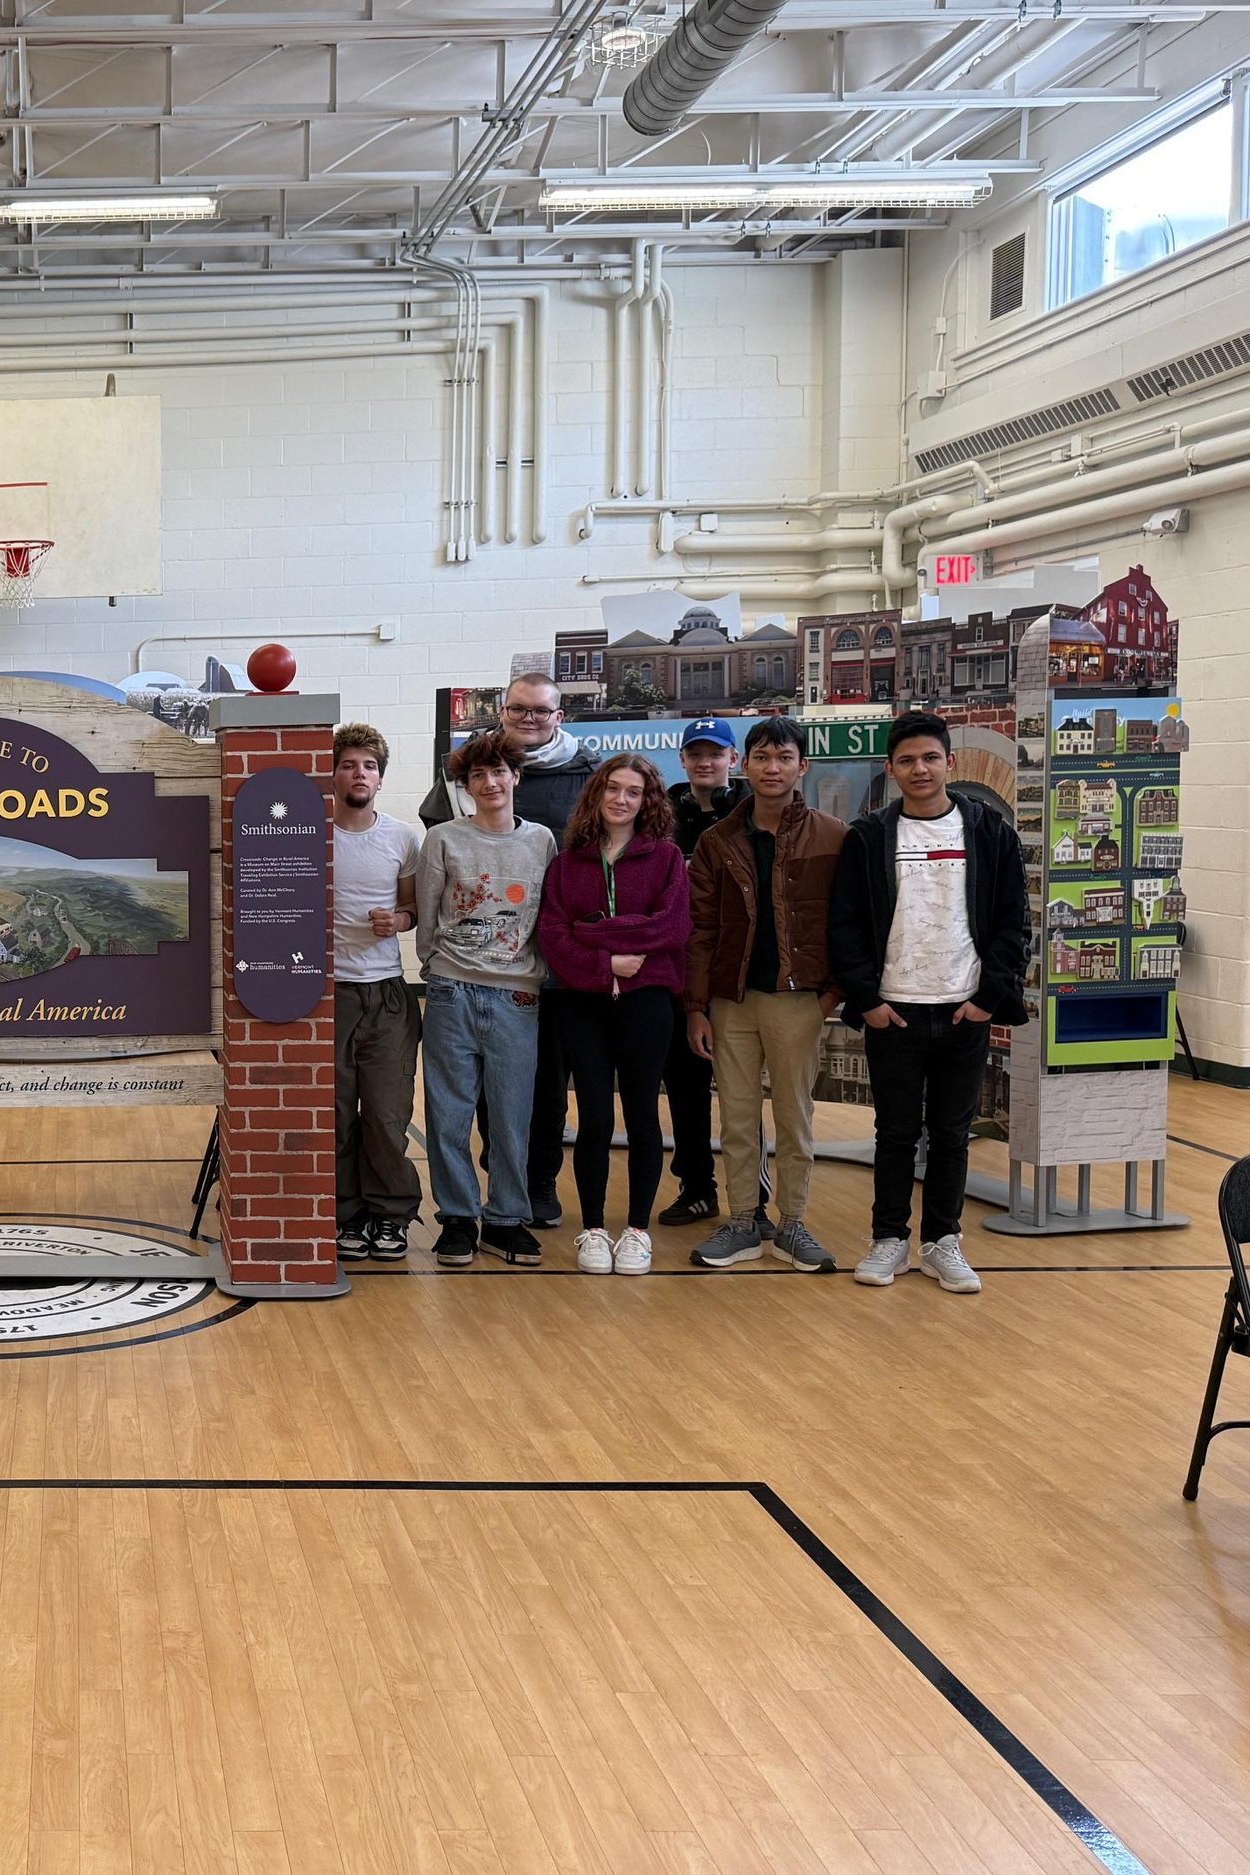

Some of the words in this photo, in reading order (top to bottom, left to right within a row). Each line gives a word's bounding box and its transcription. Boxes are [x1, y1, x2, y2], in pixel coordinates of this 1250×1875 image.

[936, 555, 972, 585] EXIT
[578, 733, 684, 752] OMMUNI
[808, 726, 830, 755] IN
[848, 725, 878, 754] ST
[20, 746, 50, 773] TO
[241, 823, 316, 836] Smithsonian
[26, 999, 127, 1022] America
[20, 1077, 50, 1091] and
[54, 1077, 102, 1095] change
[107, 1077, 118, 1090] is
[123, 1078, 185, 1090] constant
[2, 1240, 92, 1255] RIVERTON
